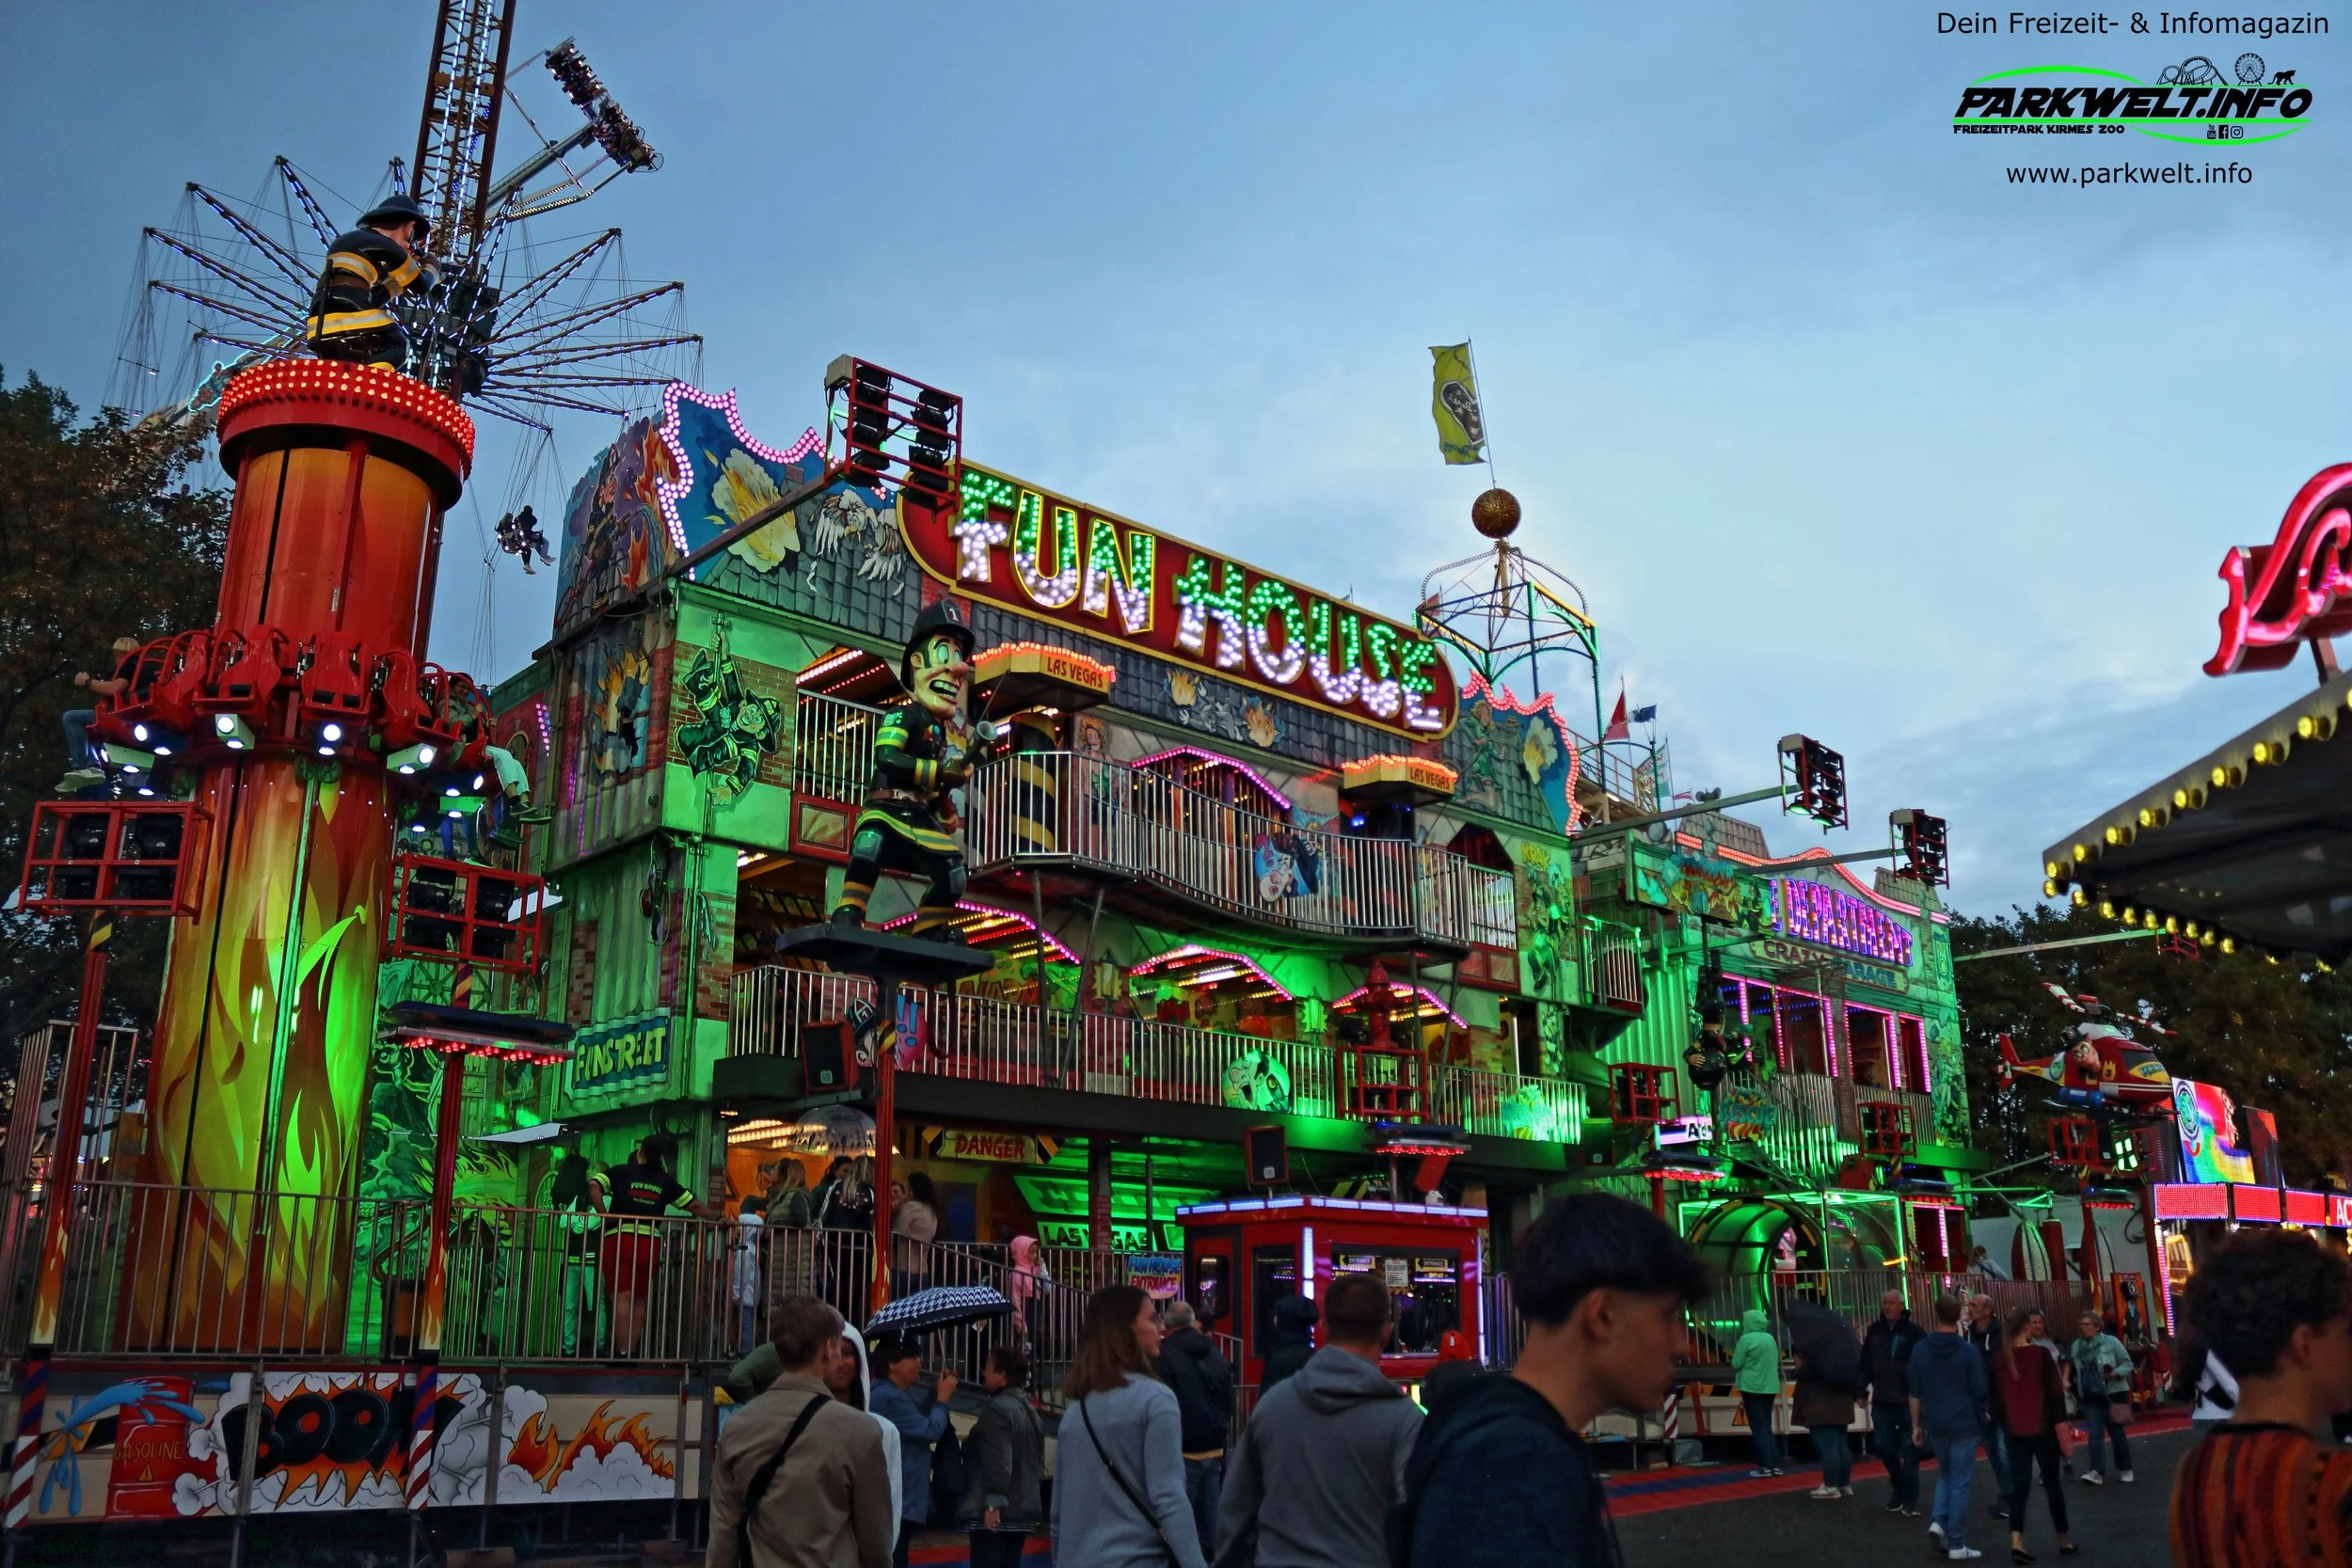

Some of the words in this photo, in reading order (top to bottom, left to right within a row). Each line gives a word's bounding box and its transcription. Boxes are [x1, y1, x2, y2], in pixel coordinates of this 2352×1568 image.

[952, 467, 1156, 635] FUN
[1172, 551, 1447, 733] HOUSE
[1046, 657, 1067, 677] LAS
[1070, 663, 1104, 689] VEGAS
[1410, 767, 1424, 784] LAS
[1426, 770, 1451, 790] VEGAS
[1784, 878, 1914, 967] DEPARTMENT
[1764, 939, 1826, 966] CRAZY
[1846, 960, 1898, 989] ARAGE
[575, 1026, 667, 1083] FUNSTREET
[955, 1133, 1025, 1160] DANGER
[1041, 1226, 1083, 1247] LAS
[1348, 1256, 1371, 1264] ENTRANCE
[1130, 1274, 1178, 1295] ENTRANCE
[113, 1439, 184, 1464] GASOLINE
